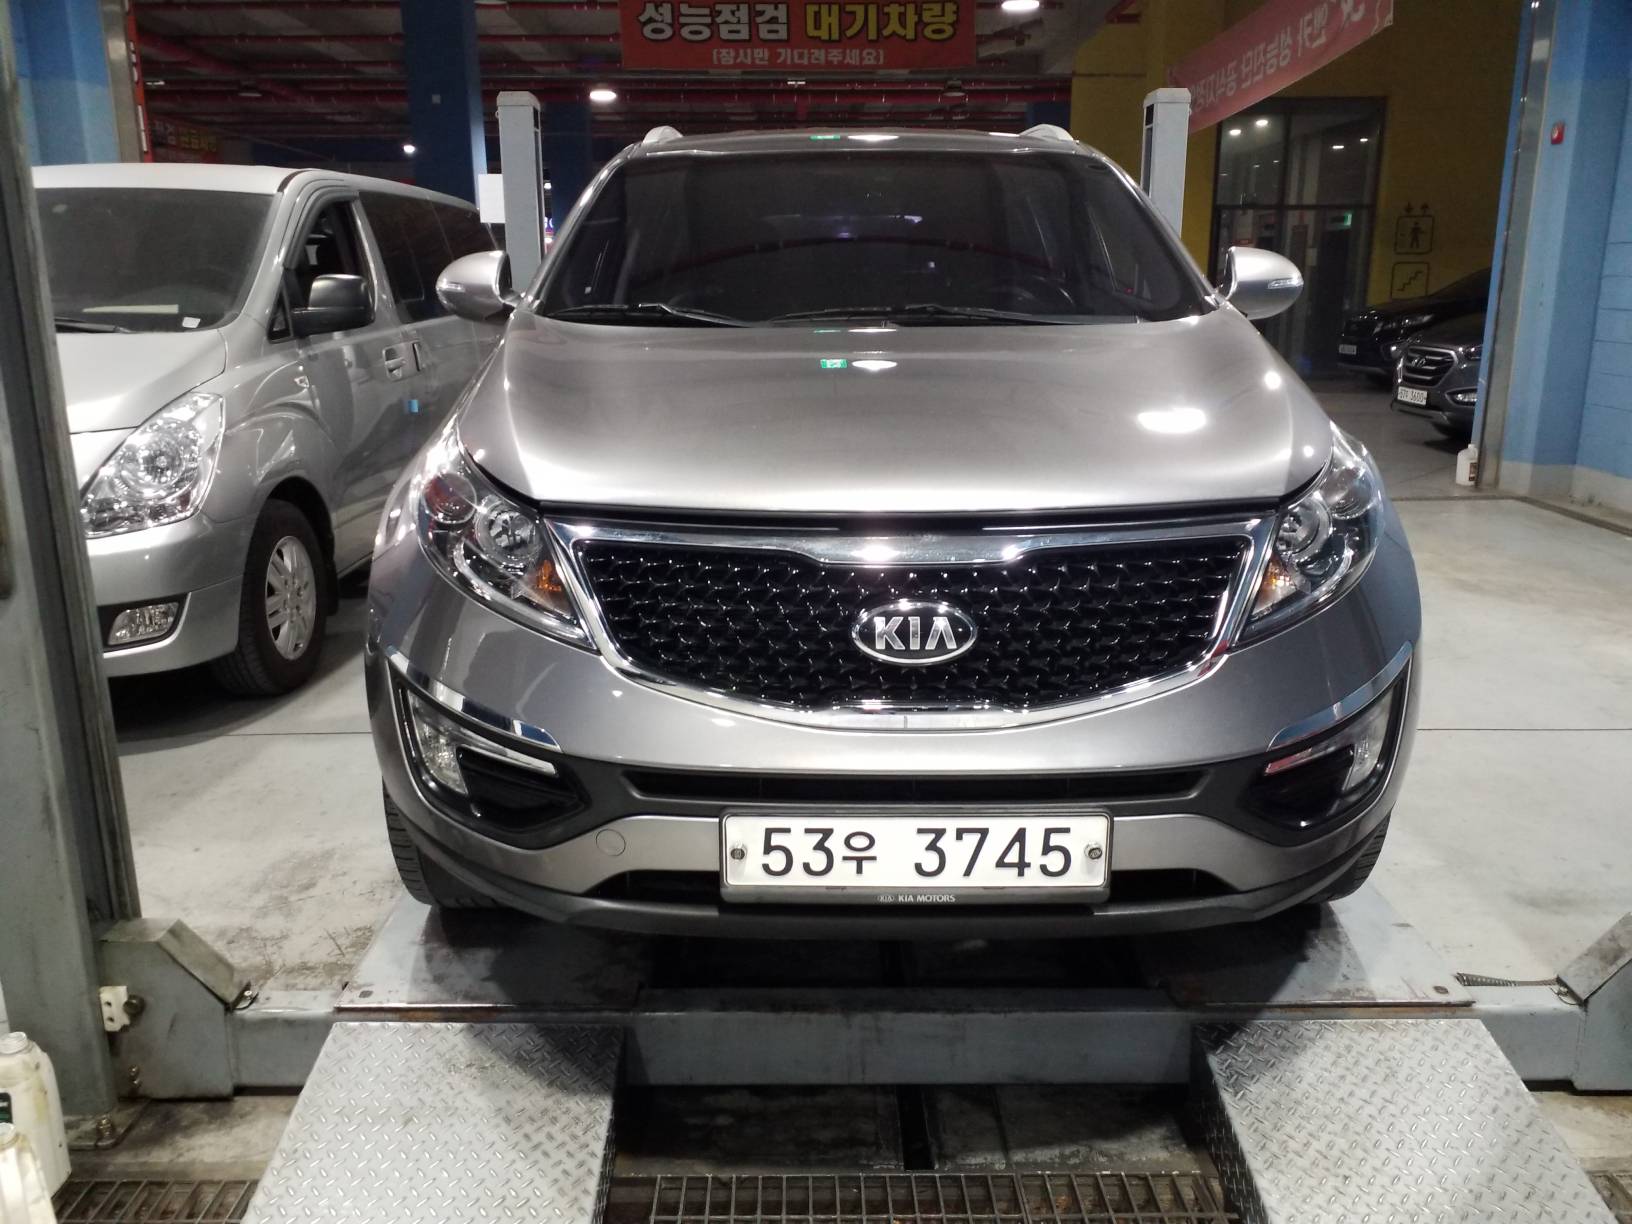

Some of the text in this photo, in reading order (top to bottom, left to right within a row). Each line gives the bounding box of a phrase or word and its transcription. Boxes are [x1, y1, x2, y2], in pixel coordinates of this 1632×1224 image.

[637, 2, 958, 41] 성능점검 대기차량
[873, 616, 958, 650] KIA
[761, 827, 1072, 878] 53우 3745
[898, 894, 956, 903] KIA MOTORS
